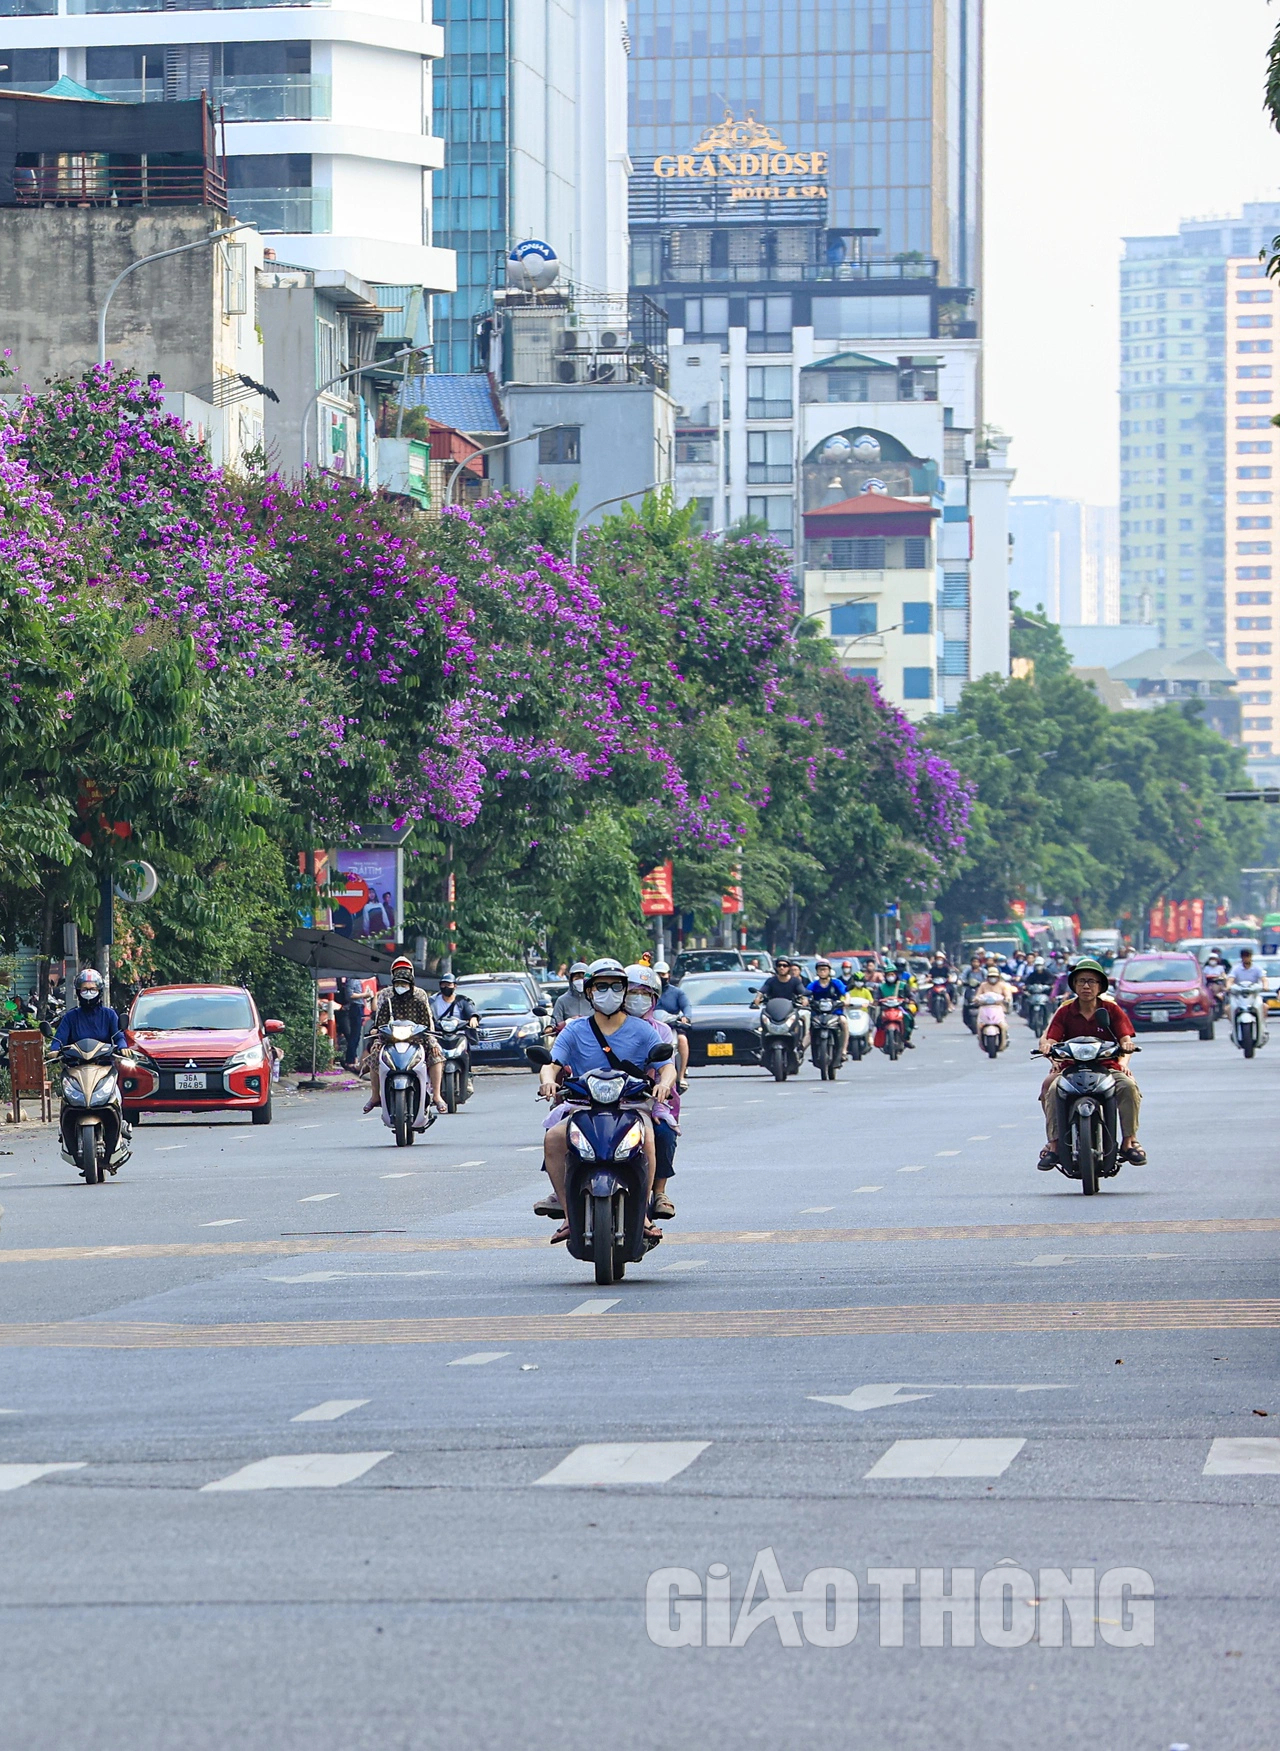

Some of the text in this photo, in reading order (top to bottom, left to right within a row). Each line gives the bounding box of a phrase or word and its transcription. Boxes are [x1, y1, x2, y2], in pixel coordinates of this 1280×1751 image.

[653, 151, 828, 178] GRANDIOSE
[731, 186, 828, 199] HOTEL & SPA
